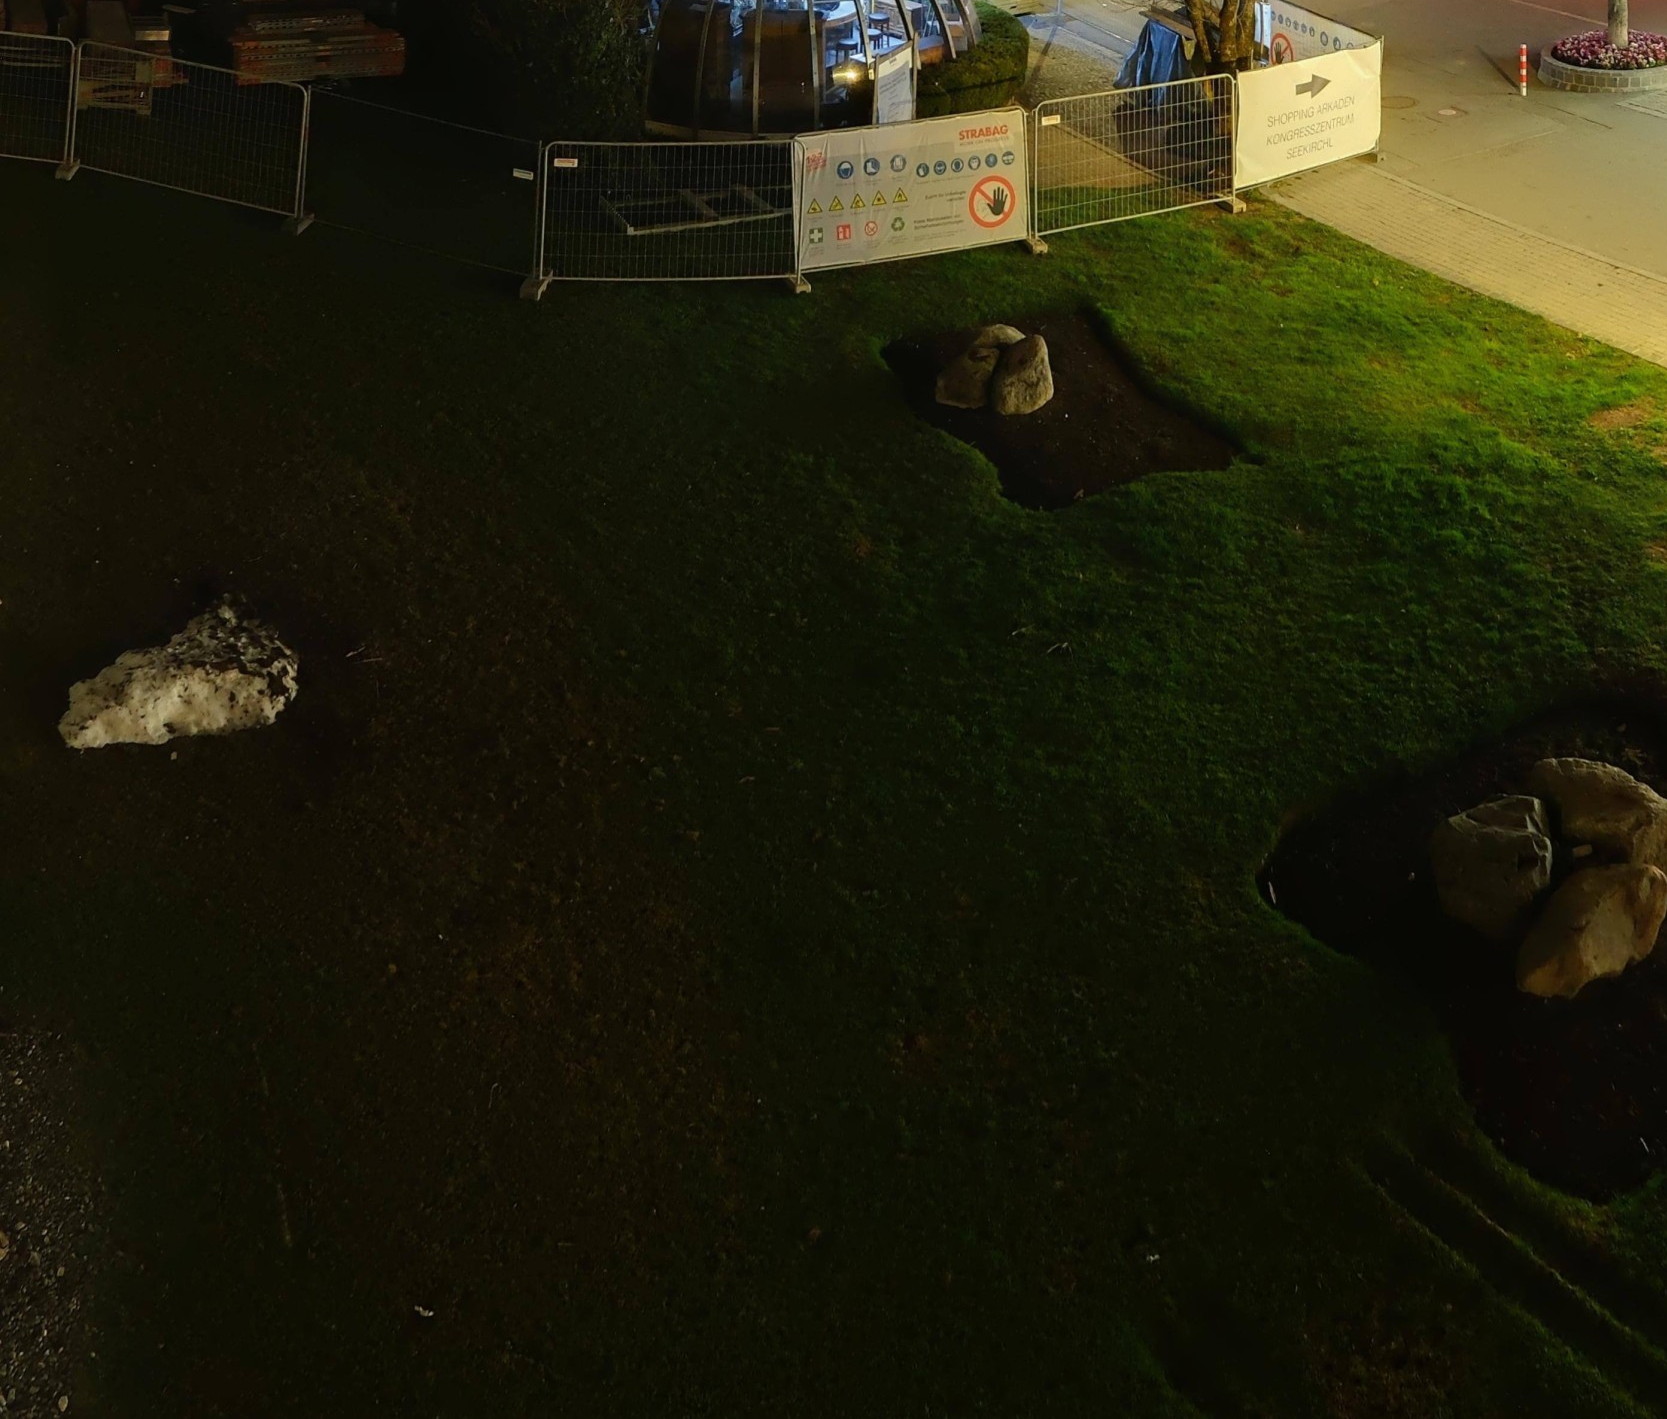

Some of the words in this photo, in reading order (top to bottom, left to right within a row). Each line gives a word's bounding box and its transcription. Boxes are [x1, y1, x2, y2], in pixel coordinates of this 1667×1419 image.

[1267, 106, 1315, 128] SHOPPING
[1316, 95, 1355, 116] ARKADEN
[958, 124, 1009, 141] STRABAG
[1266, 113, 1355, 146] KONGRESSZENTRUM
[1286, 138, 1334, 160] SEEKIRCHL
